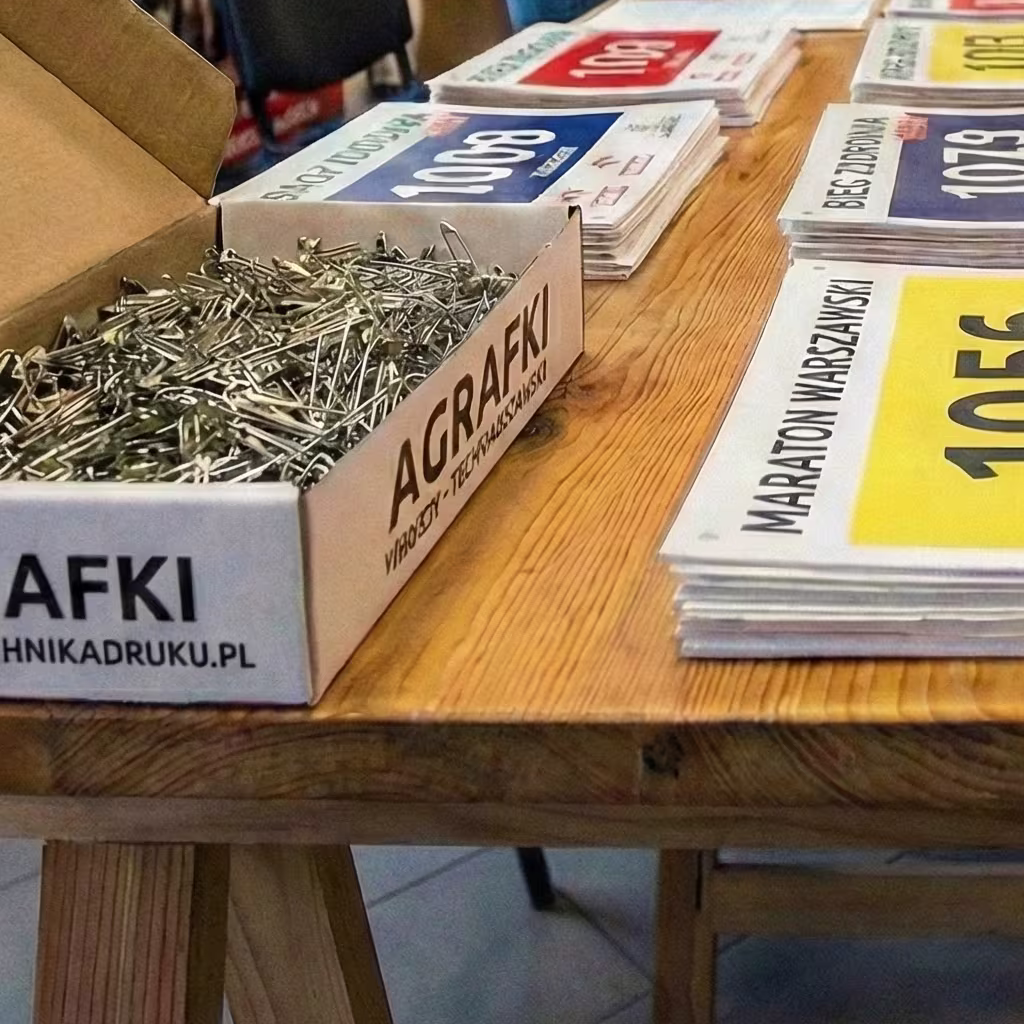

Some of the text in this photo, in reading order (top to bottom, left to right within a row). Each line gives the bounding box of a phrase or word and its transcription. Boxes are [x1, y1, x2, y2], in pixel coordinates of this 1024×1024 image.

[821, 179, 872, 210] BIEG
[388, 282, 549, 534] AGRAFKI
[740, 278, 874, 535] MARATON WARSZAWSKI
[4, 553, 198, 623] AFKI
[2, 637, 257, 669] HNIKADRUKU.PL
